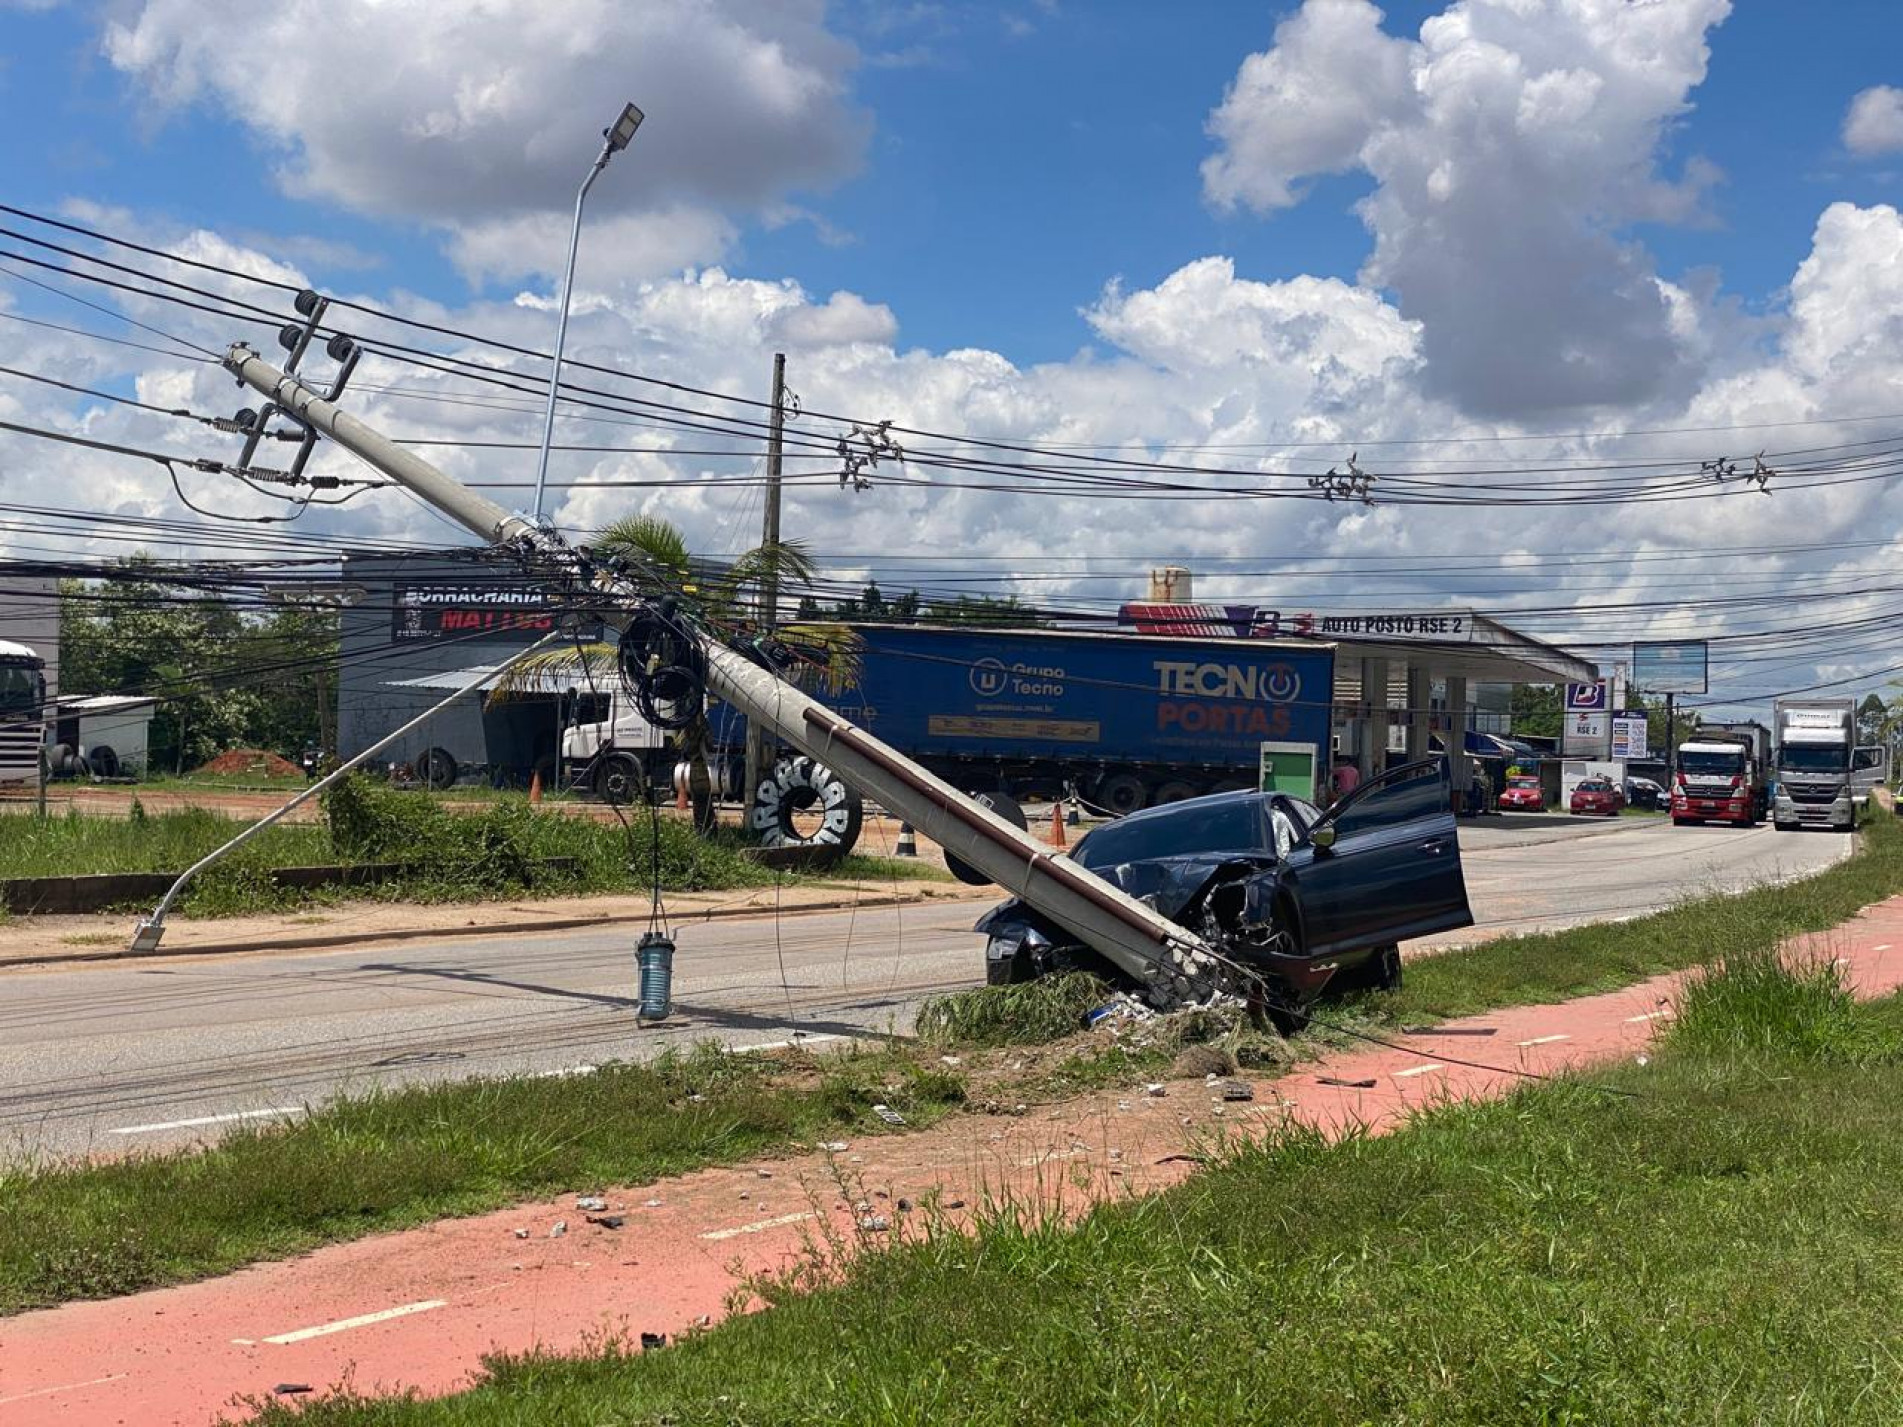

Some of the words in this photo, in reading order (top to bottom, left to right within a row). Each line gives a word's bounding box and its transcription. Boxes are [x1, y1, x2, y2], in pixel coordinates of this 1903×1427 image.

[1321, 616, 1360, 633] AUTO
[1365, 615, 1414, 634] POSTO
[1419, 617, 1447, 633] RSE
[1453, 617, 1462, 633] 2
[1012, 678, 1064, 696] Tecno
[1156, 701, 1292, 737] PORTAS
